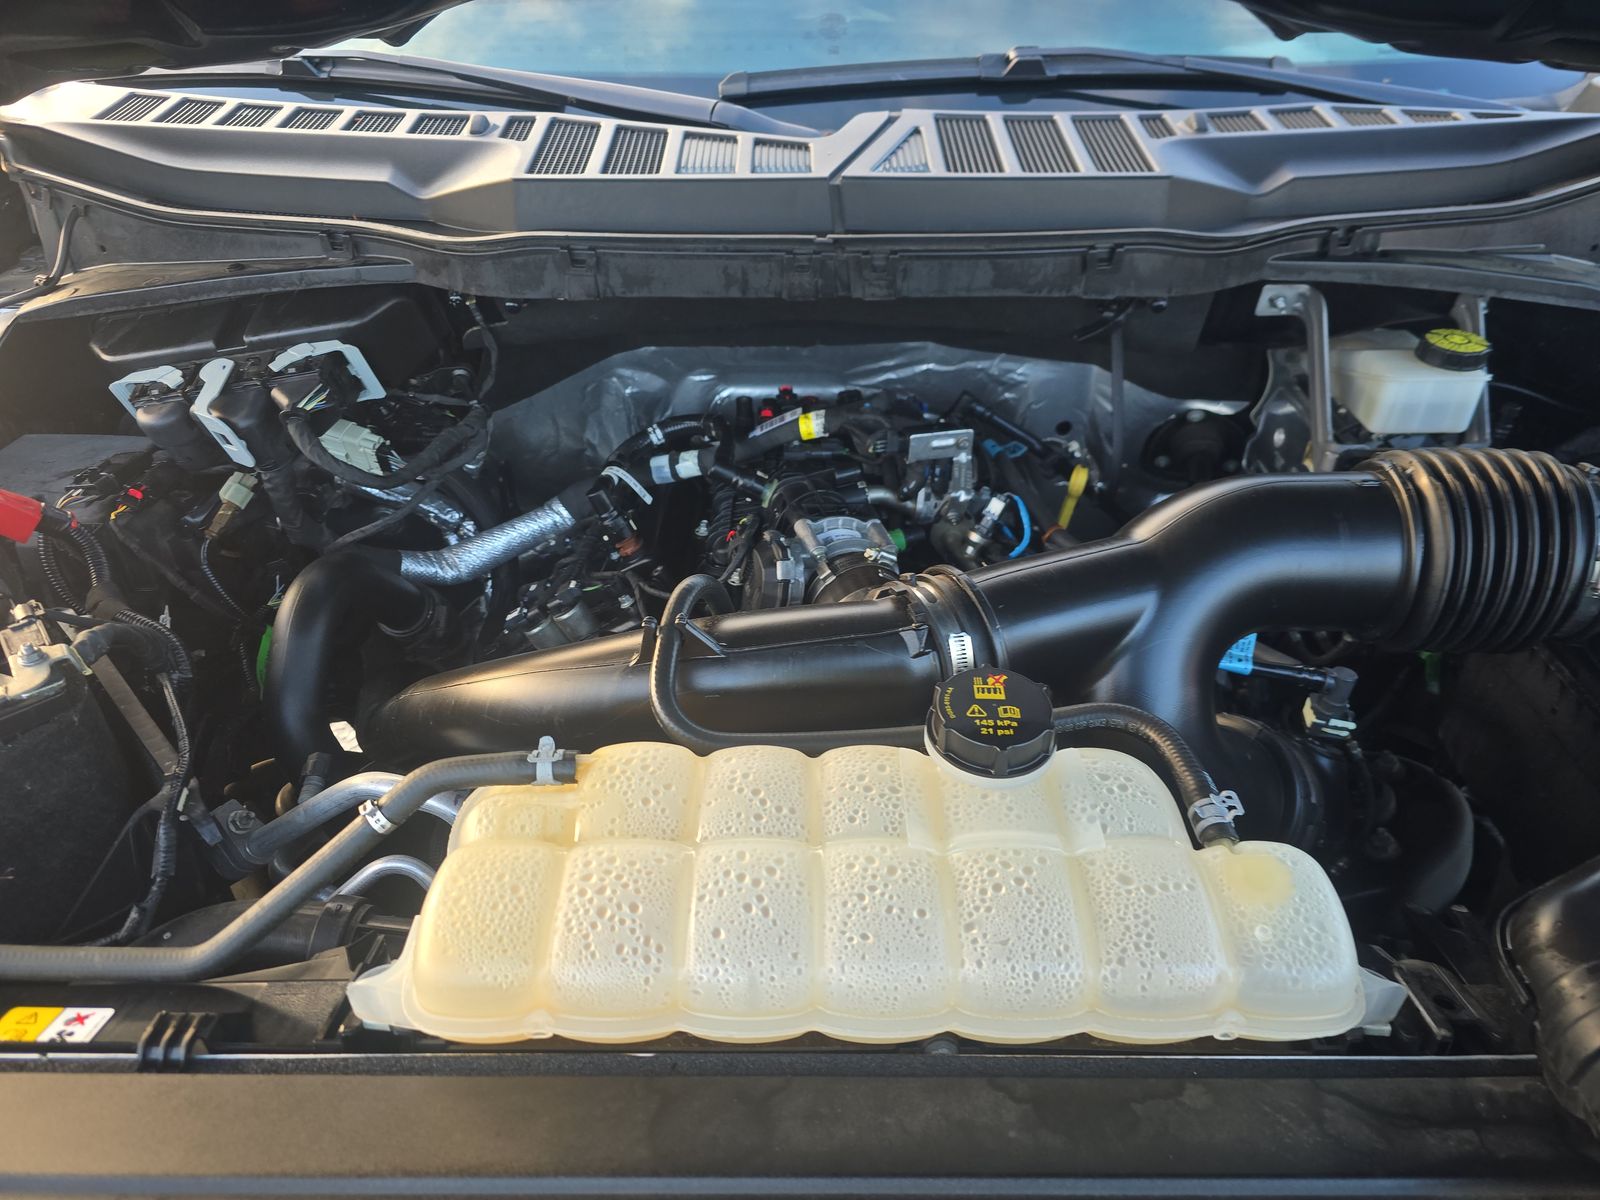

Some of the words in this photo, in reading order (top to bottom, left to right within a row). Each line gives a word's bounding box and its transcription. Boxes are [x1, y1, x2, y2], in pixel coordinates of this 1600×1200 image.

[996, 719, 1018, 727] kPa
[980, 727, 994, 735] 21
[997, 728, 1014, 736] psi
